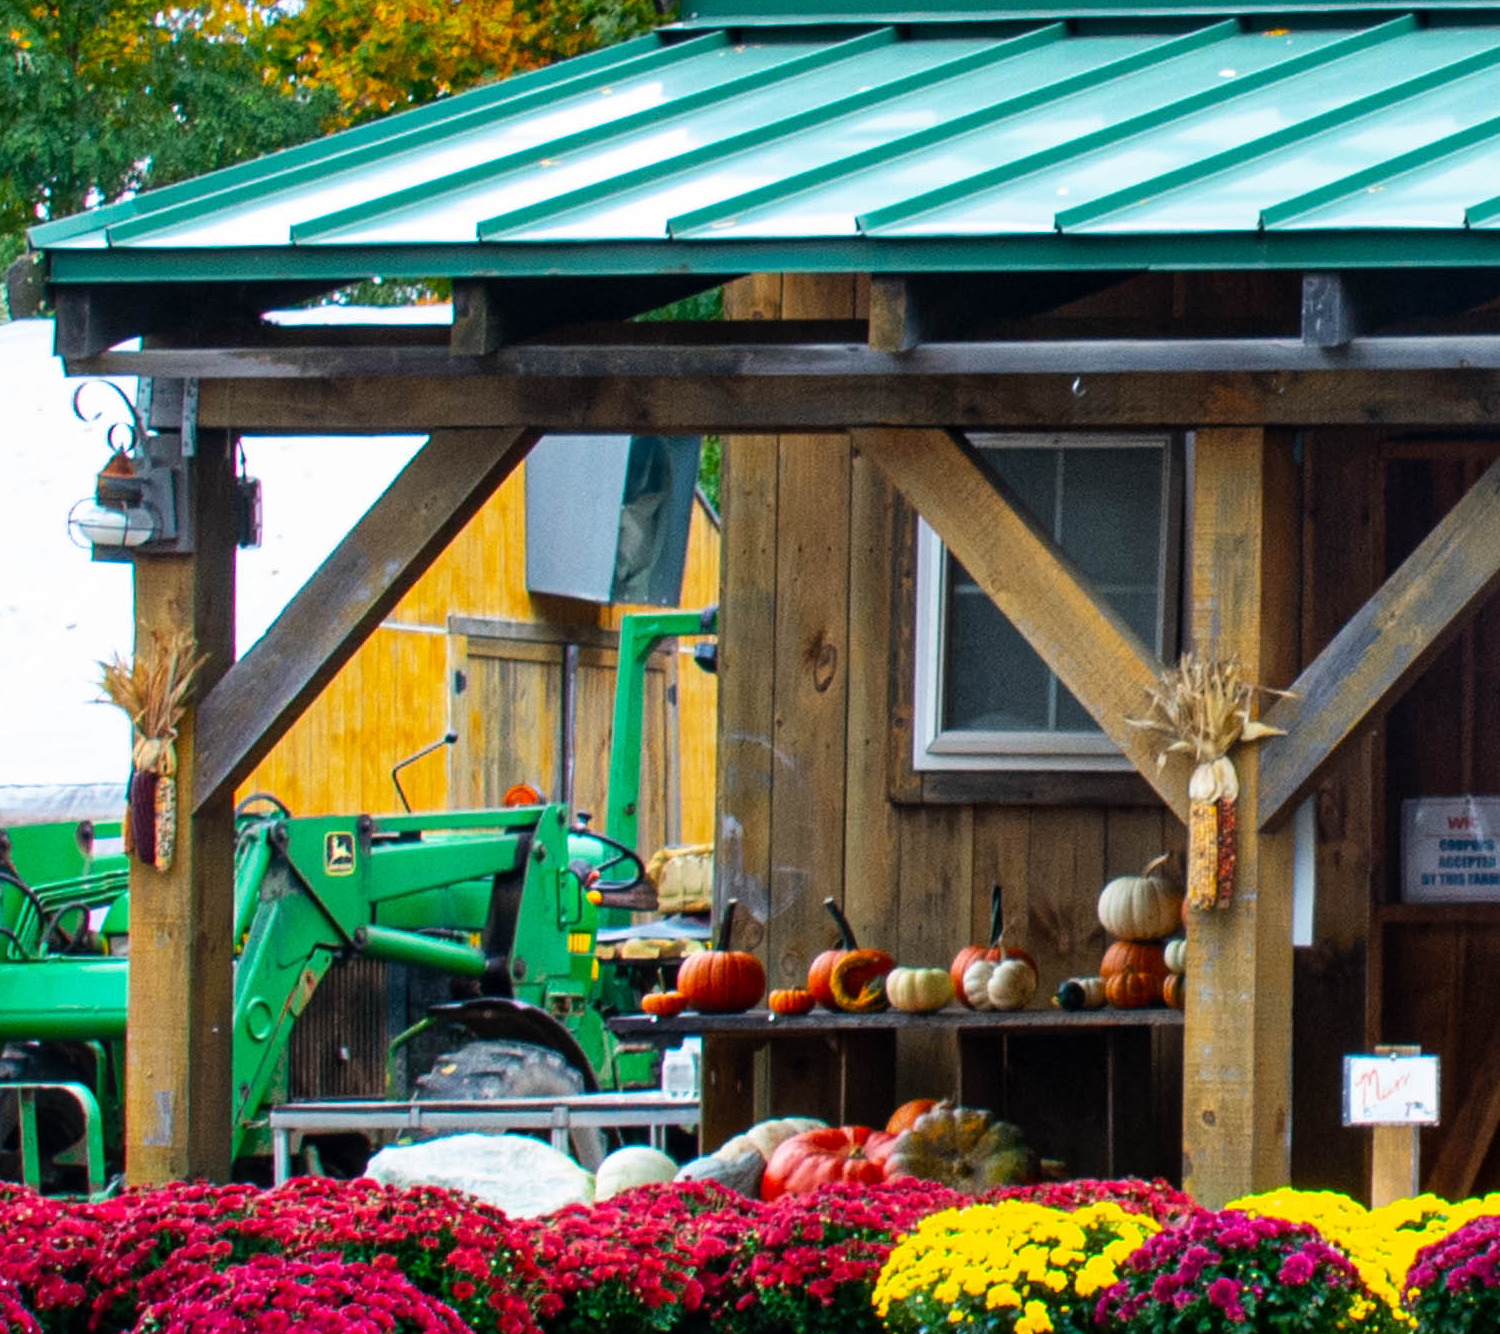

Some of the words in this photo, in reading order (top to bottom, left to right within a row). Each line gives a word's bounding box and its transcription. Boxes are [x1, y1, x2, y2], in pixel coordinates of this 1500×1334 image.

[1438, 839, 1495, 852] COUPONS
[1438, 856, 1497, 868] ACCEPTED
[1420, 873, 1436, 886] BY
[1438, 873, 1466, 886] THIS
